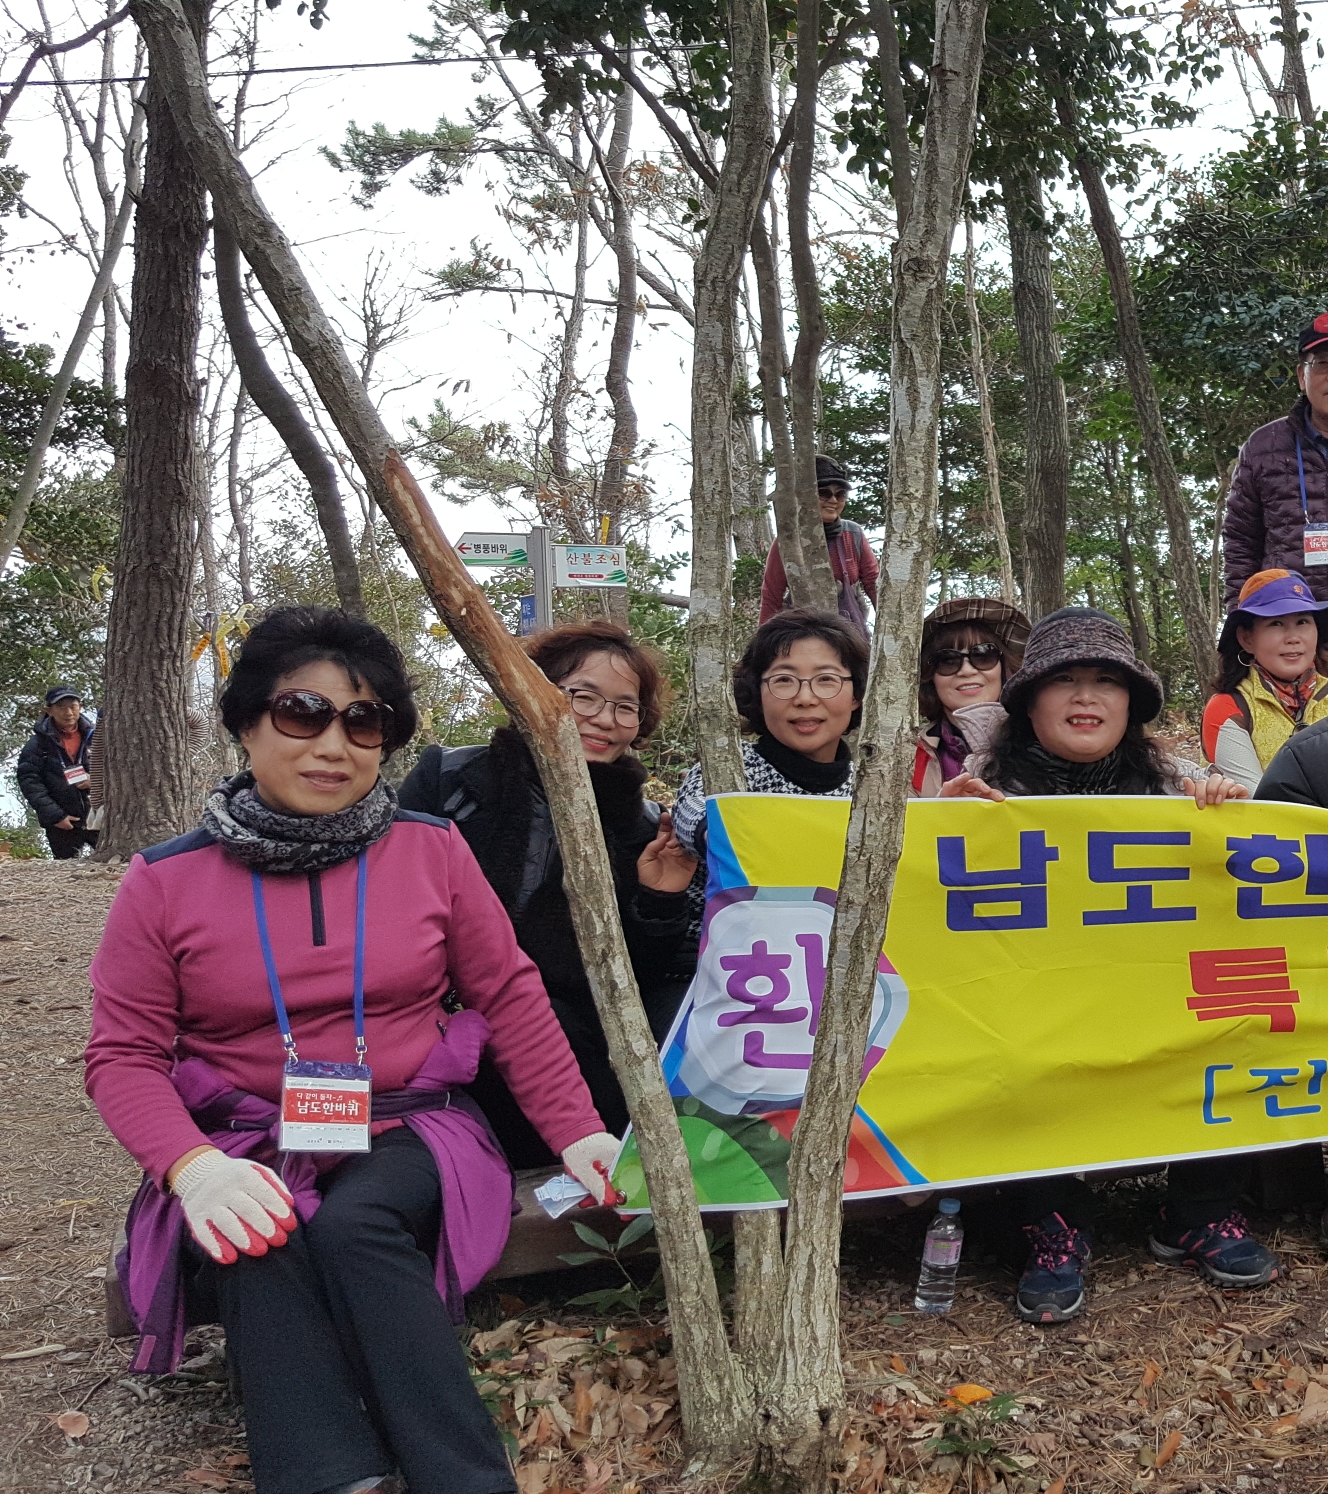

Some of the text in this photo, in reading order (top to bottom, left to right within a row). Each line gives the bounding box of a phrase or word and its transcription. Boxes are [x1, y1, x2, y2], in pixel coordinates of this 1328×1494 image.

[473, 543, 508, 554] 병풍바위
[566, 552, 620, 566] 산불조심
[718, 933, 828, 1070] 환
[297, 1101, 359, 1116] 남도한바퀴
